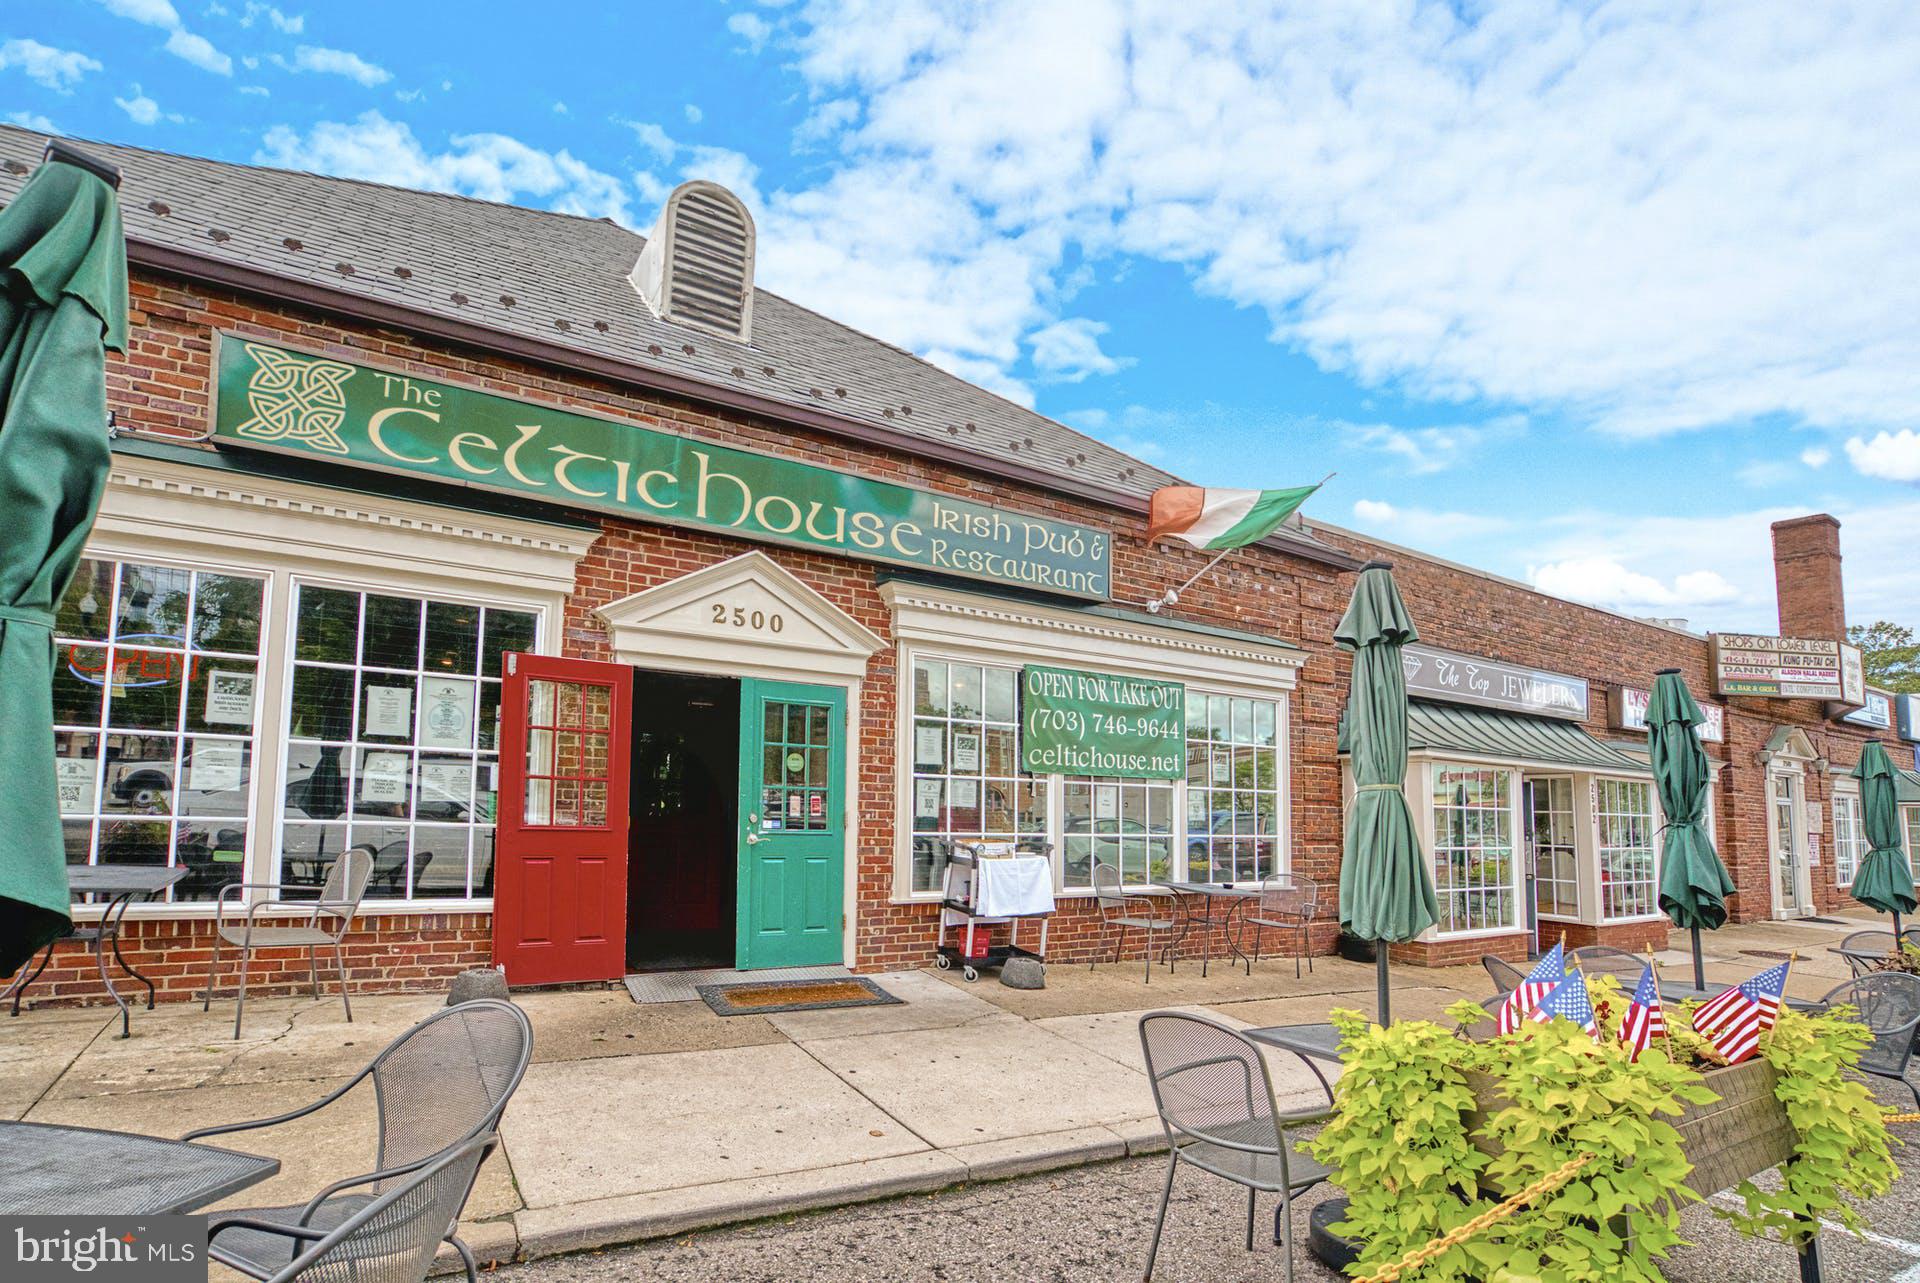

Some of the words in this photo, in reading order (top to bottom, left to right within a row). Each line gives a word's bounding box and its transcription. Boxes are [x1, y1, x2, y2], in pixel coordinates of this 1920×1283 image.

[374, 373, 442, 407] The
[932, 502, 1012, 544] Irish
[1023, 522, 1084, 557] Pub
[1090, 535, 1104, 561] &
[930, 538, 1103, 594] Restaurant
[712, 603, 784, 633] 2500
[1723, 635, 1753, 648] SHOPS
[1757, 637, 1773, 649] ON
[1777, 638, 1807, 651] LOWER
[1810, 640, 1833, 652] LEVEL
[1723, 666, 1774, 674] DANNY
[1783, 655, 1800, 665] KUNG
[1825, 657, 1836, 667] CHI
[1029, 671, 1073, 699] OPEN
[1077, 676, 1109, 703] FOR
[1110, 680, 1149, 707] TAKE
[1151, 685, 1181, 710] OUT
[1435, 658, 1460, 687] The
[1466, 664, 1490, 696] Top
[1501, 674, 1579, 707] JEWELERS
[1628, 689, 1648, 708] LY'S
[1030, 708, 1086, 741] (703)
[1093, 713, 1180, 740] 746-9644
[1029, 744, 1180, 772] celtichouse.net
